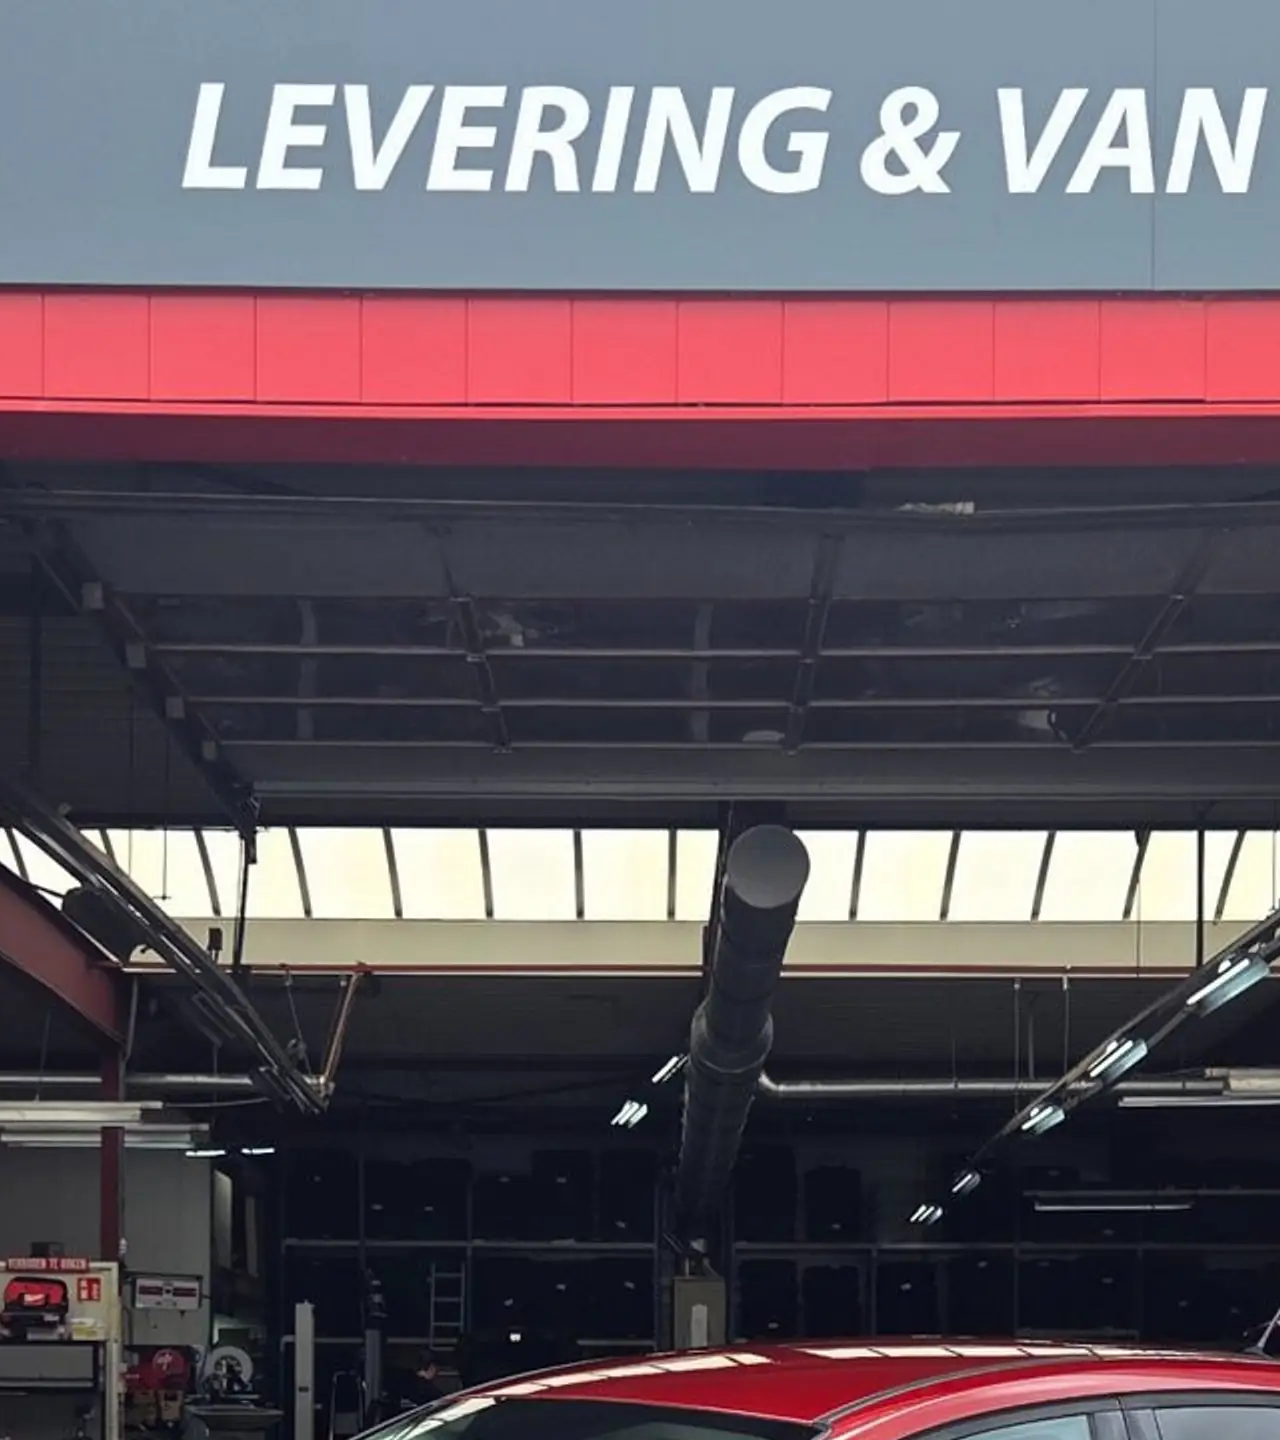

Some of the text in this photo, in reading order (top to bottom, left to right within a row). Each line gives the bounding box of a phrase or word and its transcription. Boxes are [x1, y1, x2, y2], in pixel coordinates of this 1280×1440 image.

[181, 82, 833, 195] LEVERING
[859, 86, 961, 195] &
[996, 87, 1268, 194] VAN
